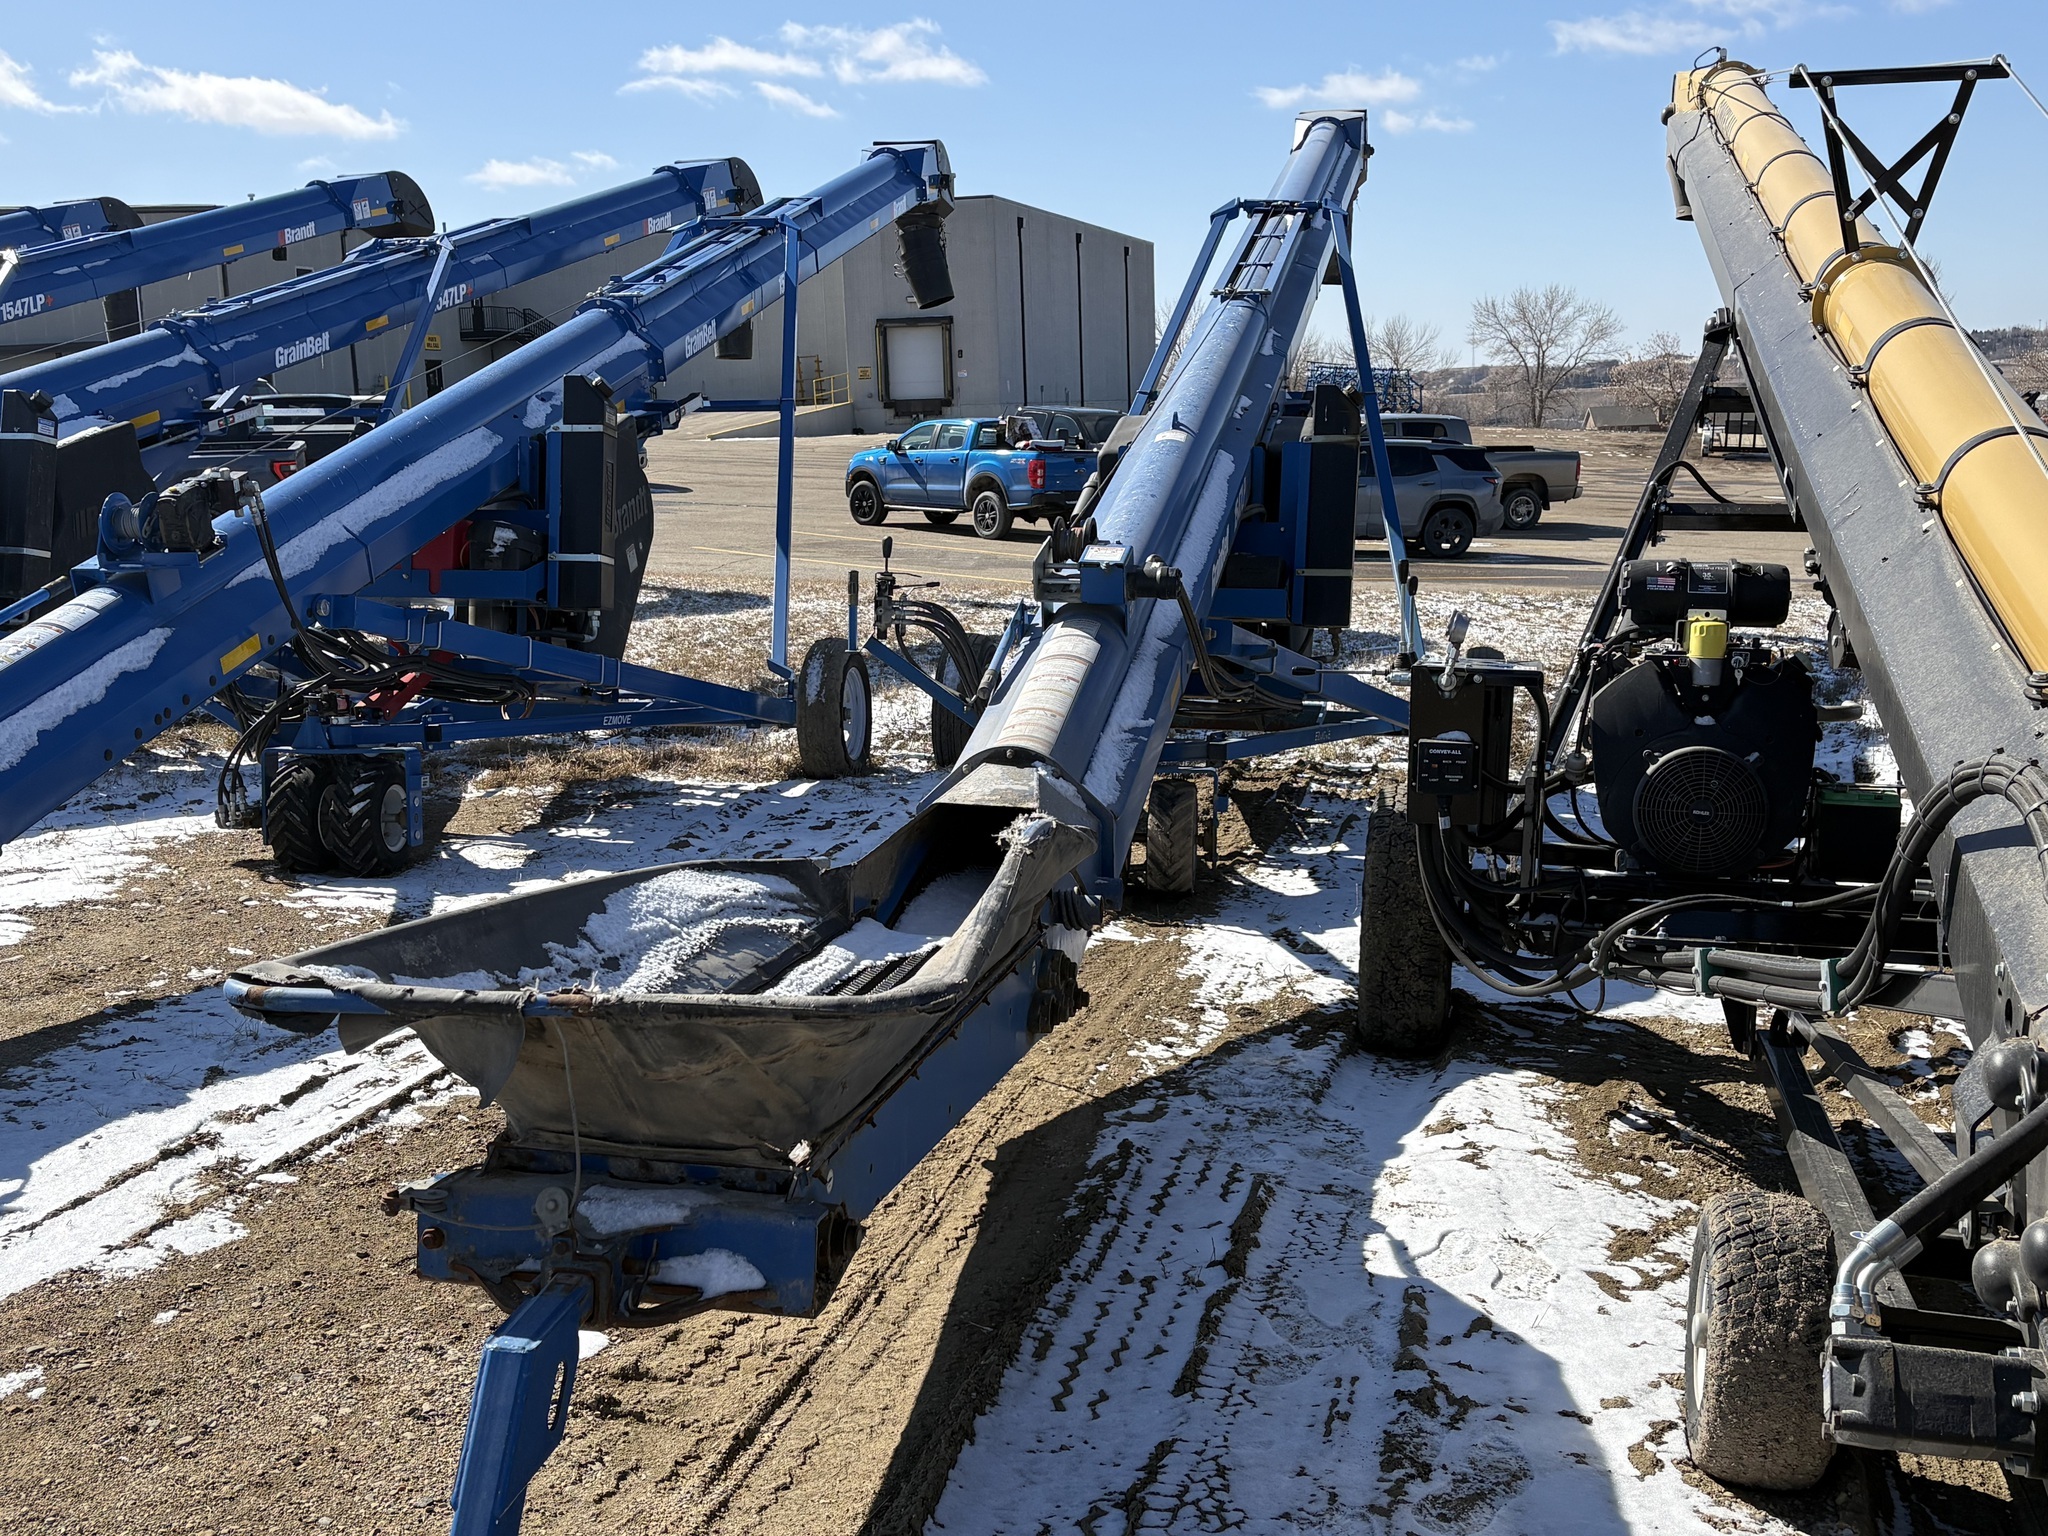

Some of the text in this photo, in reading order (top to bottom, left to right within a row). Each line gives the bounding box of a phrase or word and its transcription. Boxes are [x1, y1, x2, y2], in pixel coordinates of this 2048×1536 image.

[284, 220, 316, 245] Brandt
[648, 211, 672, 235] Brandt
[275, 331, 330, 369] GrainBelt
[685, 318, 717, 359] GrainBelt
[603, 714, 632, 726] EZMOVE
